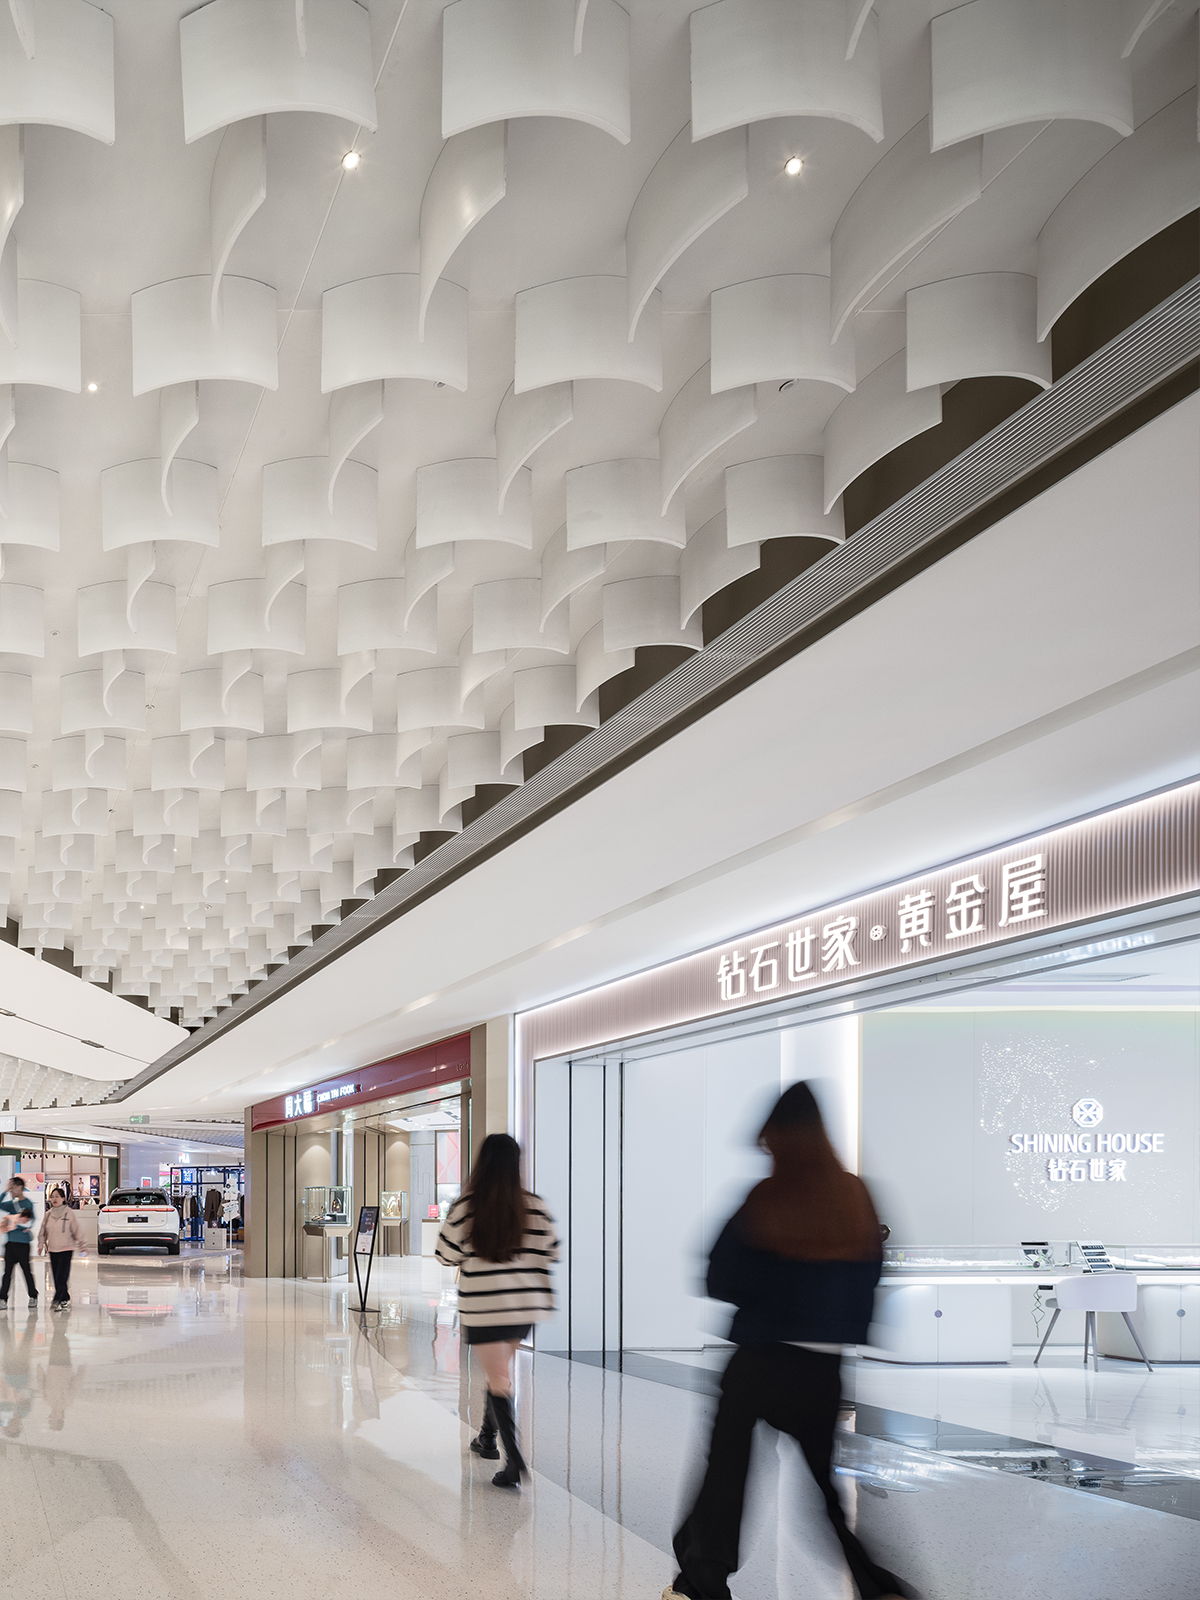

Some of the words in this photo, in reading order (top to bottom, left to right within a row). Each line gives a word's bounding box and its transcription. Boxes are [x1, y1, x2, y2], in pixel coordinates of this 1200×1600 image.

[716, 916, 861, 1001] 钻石世家
[898, 853, 1048, 953] 黄金屋
[340, 1084, 355, 1096] FOOK
[285, 1090, 314, 1119] 周大福
[1010, 1133, 1092, 1153] SHINING
[1096, 1133, 1165, 1153] HOUSE
[1048, 1157, 1127, 1182] 钻石世家
